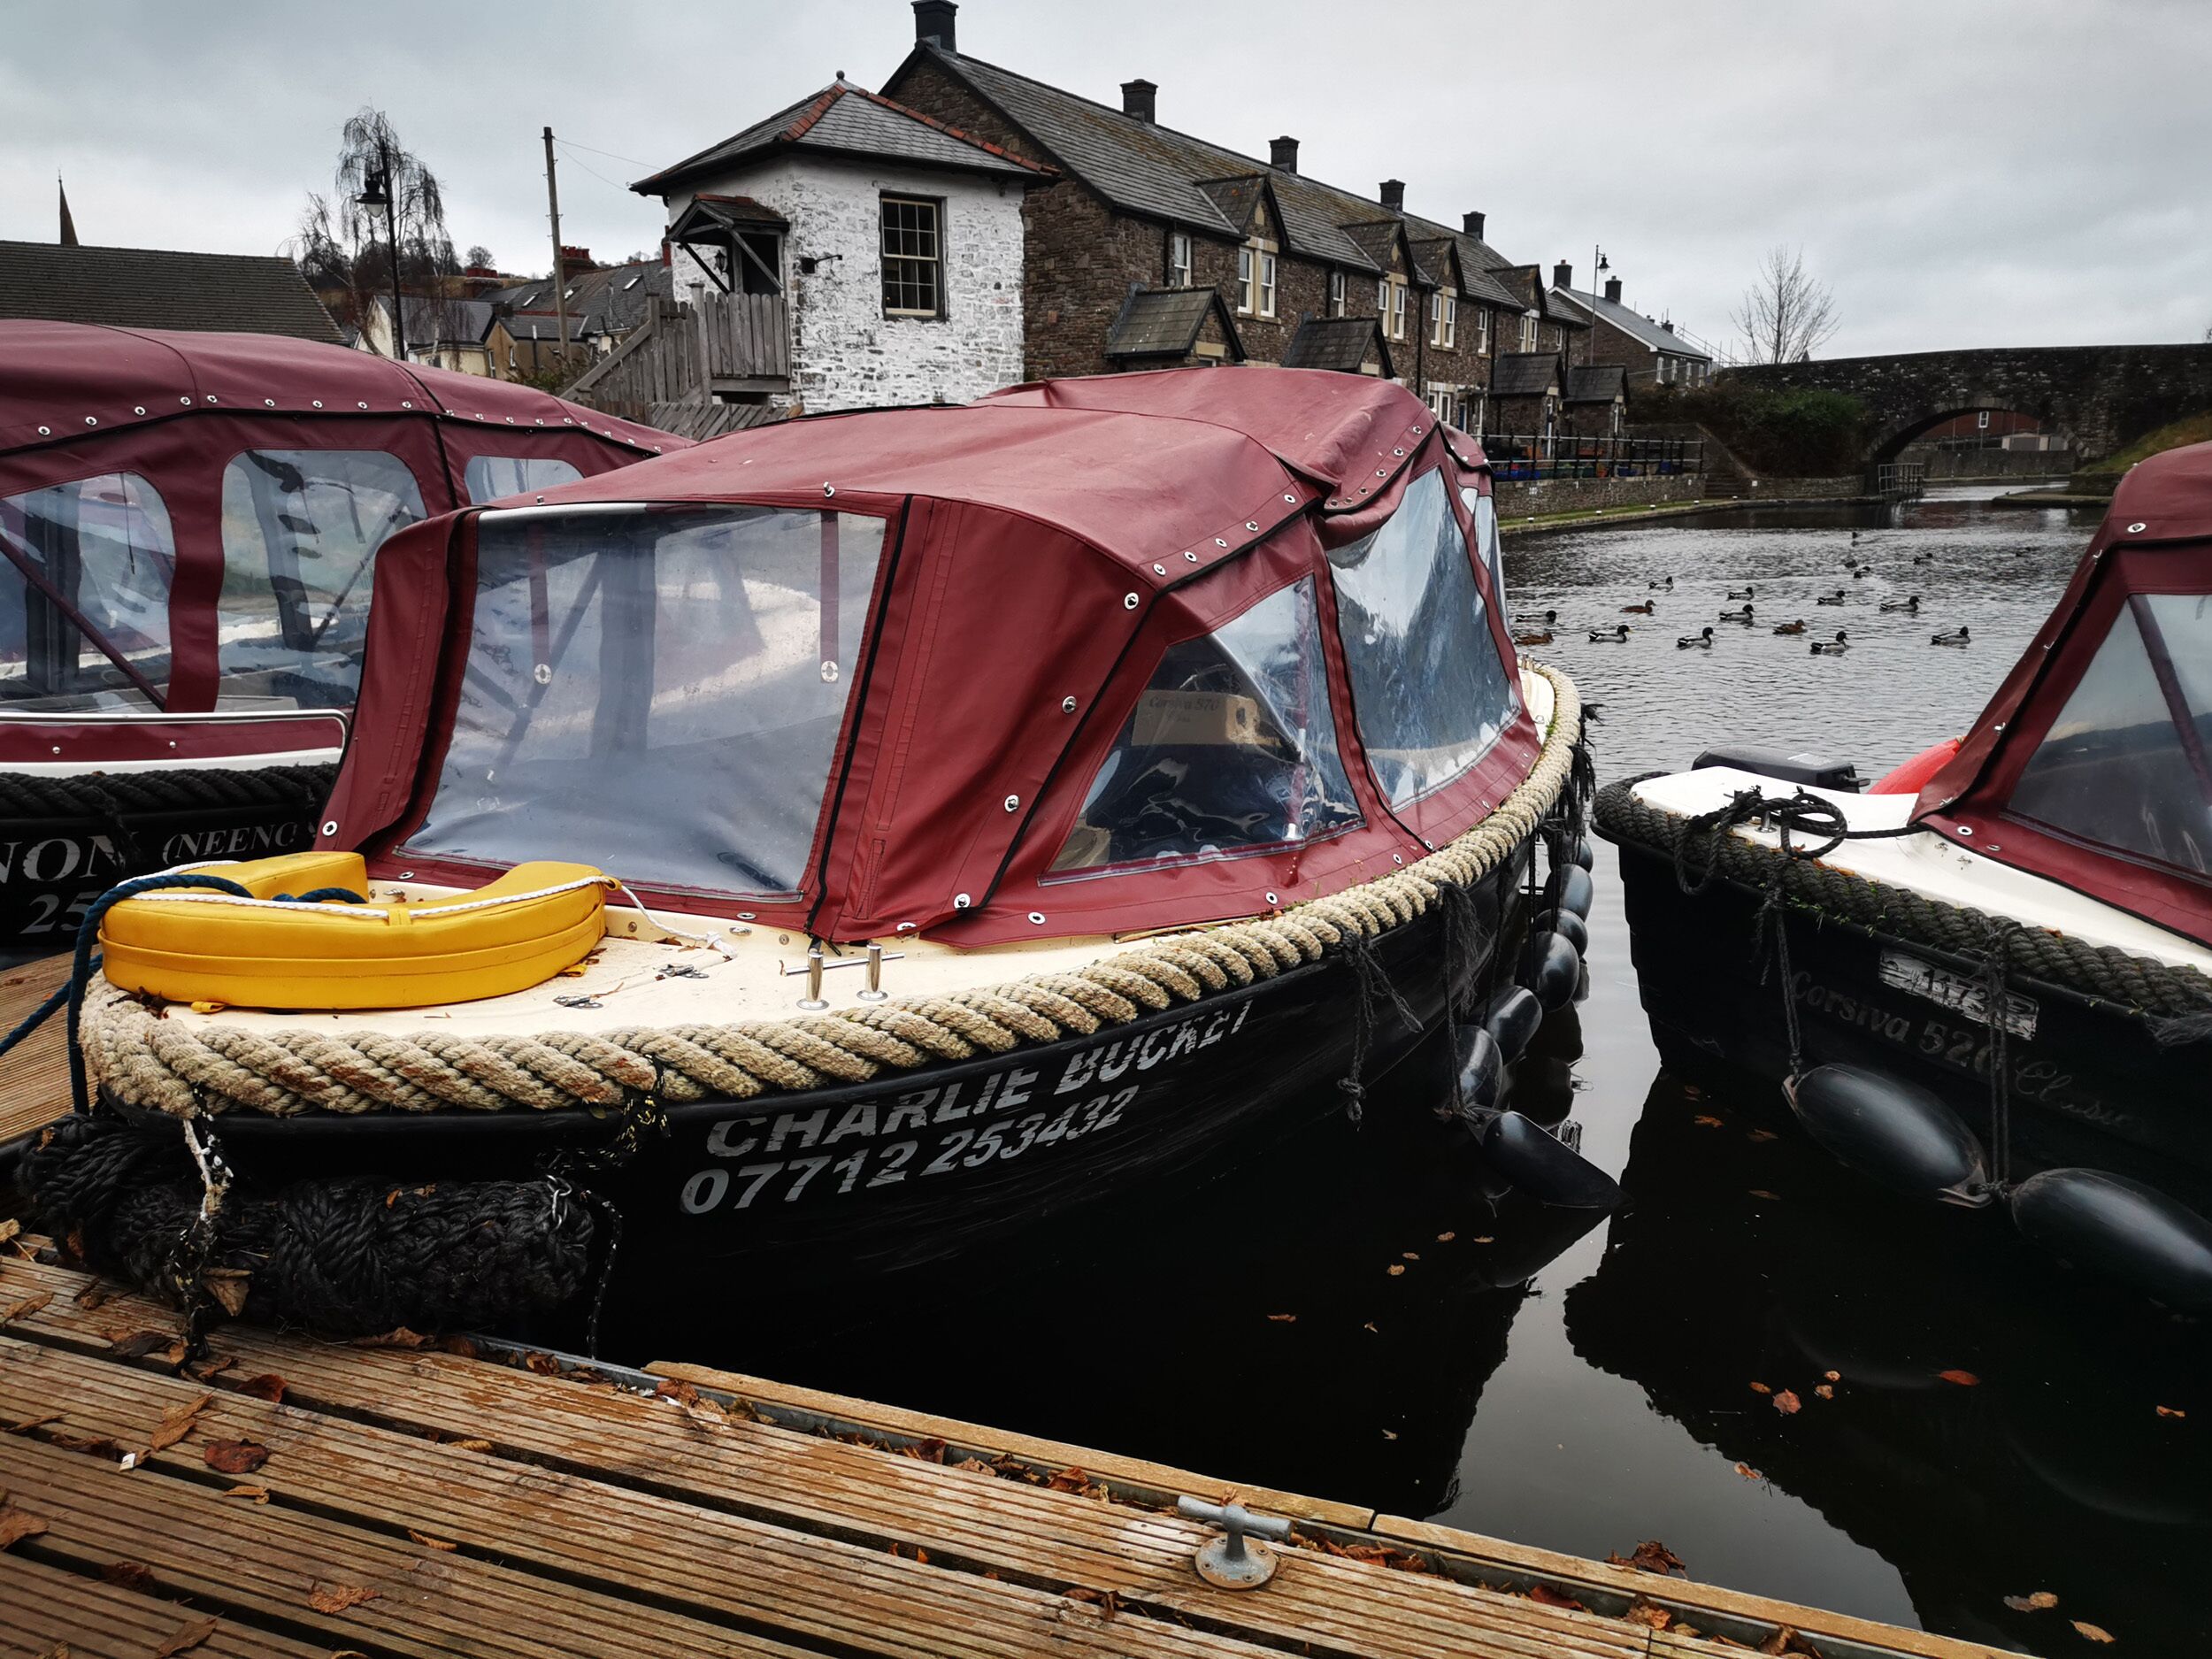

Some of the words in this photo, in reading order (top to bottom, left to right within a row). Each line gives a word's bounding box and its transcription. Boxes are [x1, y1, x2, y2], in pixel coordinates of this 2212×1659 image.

[1790, 970, 1911, 1043] Corsiva
[679, 1140, 919, 1215] 07712
[919, 1085, 1141, 1178] 253432
[705, 1064, 1041, 1159] CHARLIE
